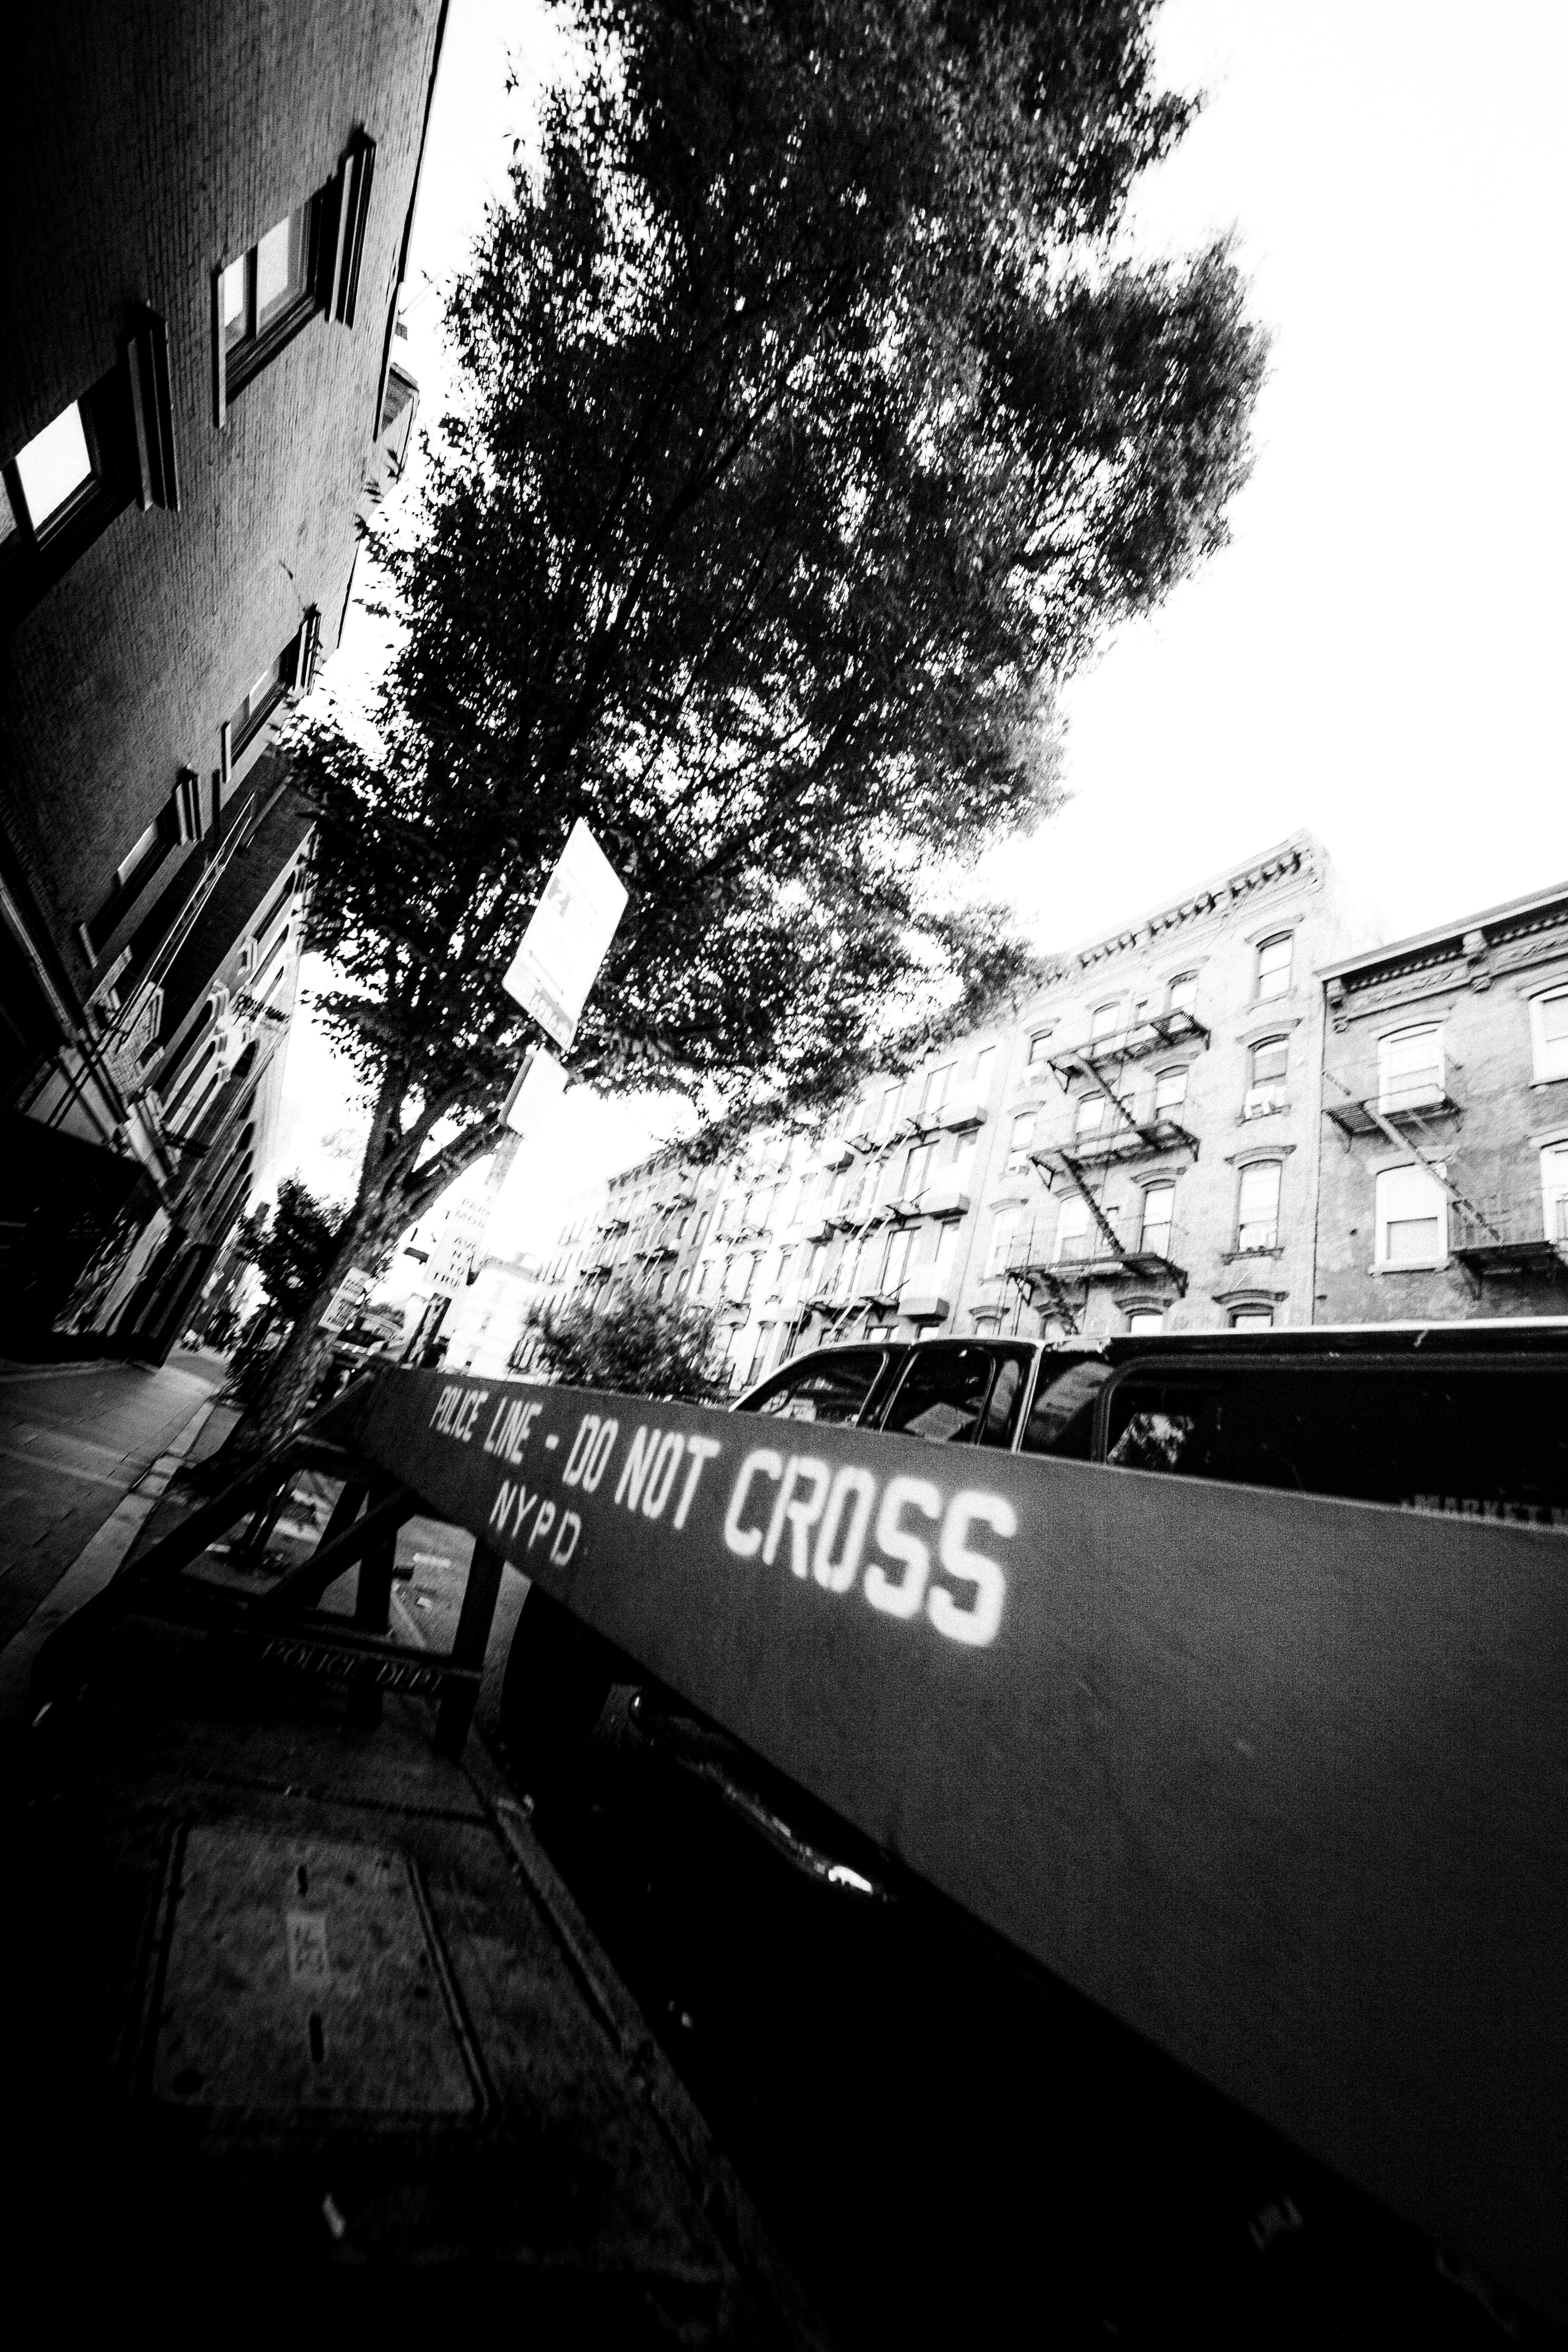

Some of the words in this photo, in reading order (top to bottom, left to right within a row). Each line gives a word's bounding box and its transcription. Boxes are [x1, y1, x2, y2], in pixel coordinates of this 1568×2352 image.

[430, 1385, 489, 1442] POLICE
[483, 1397, 543, 1465] LINE
[562, 1414, 619, 1493] DO
[614, 1426, 722, 1530] NOT
[724, 1447, 1020, 1648] CROSS
[490, 1480, 582, 1566] NYPD
